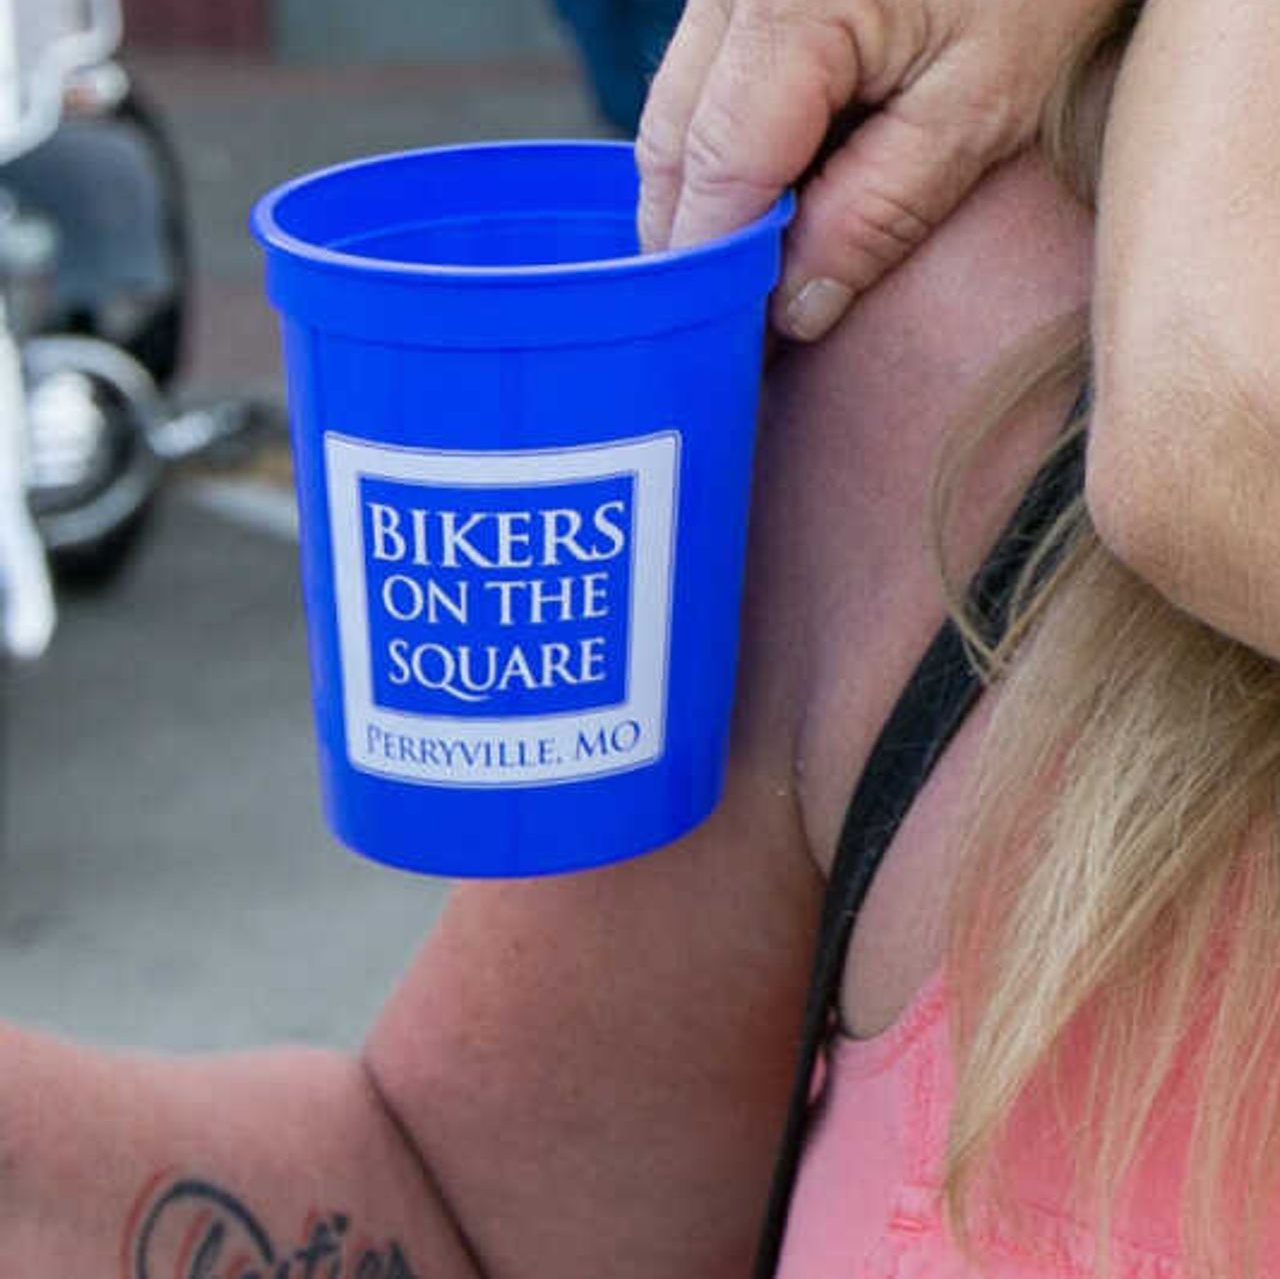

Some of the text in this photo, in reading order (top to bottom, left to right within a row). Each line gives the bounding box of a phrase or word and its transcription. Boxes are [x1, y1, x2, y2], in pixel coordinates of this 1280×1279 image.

[366, 500, 626, 569] BIKERS
[382, 572, 610, 626] ON THE
[387, 637, 607, 702] SQUARE
[574, 719, 642, 761] MO
